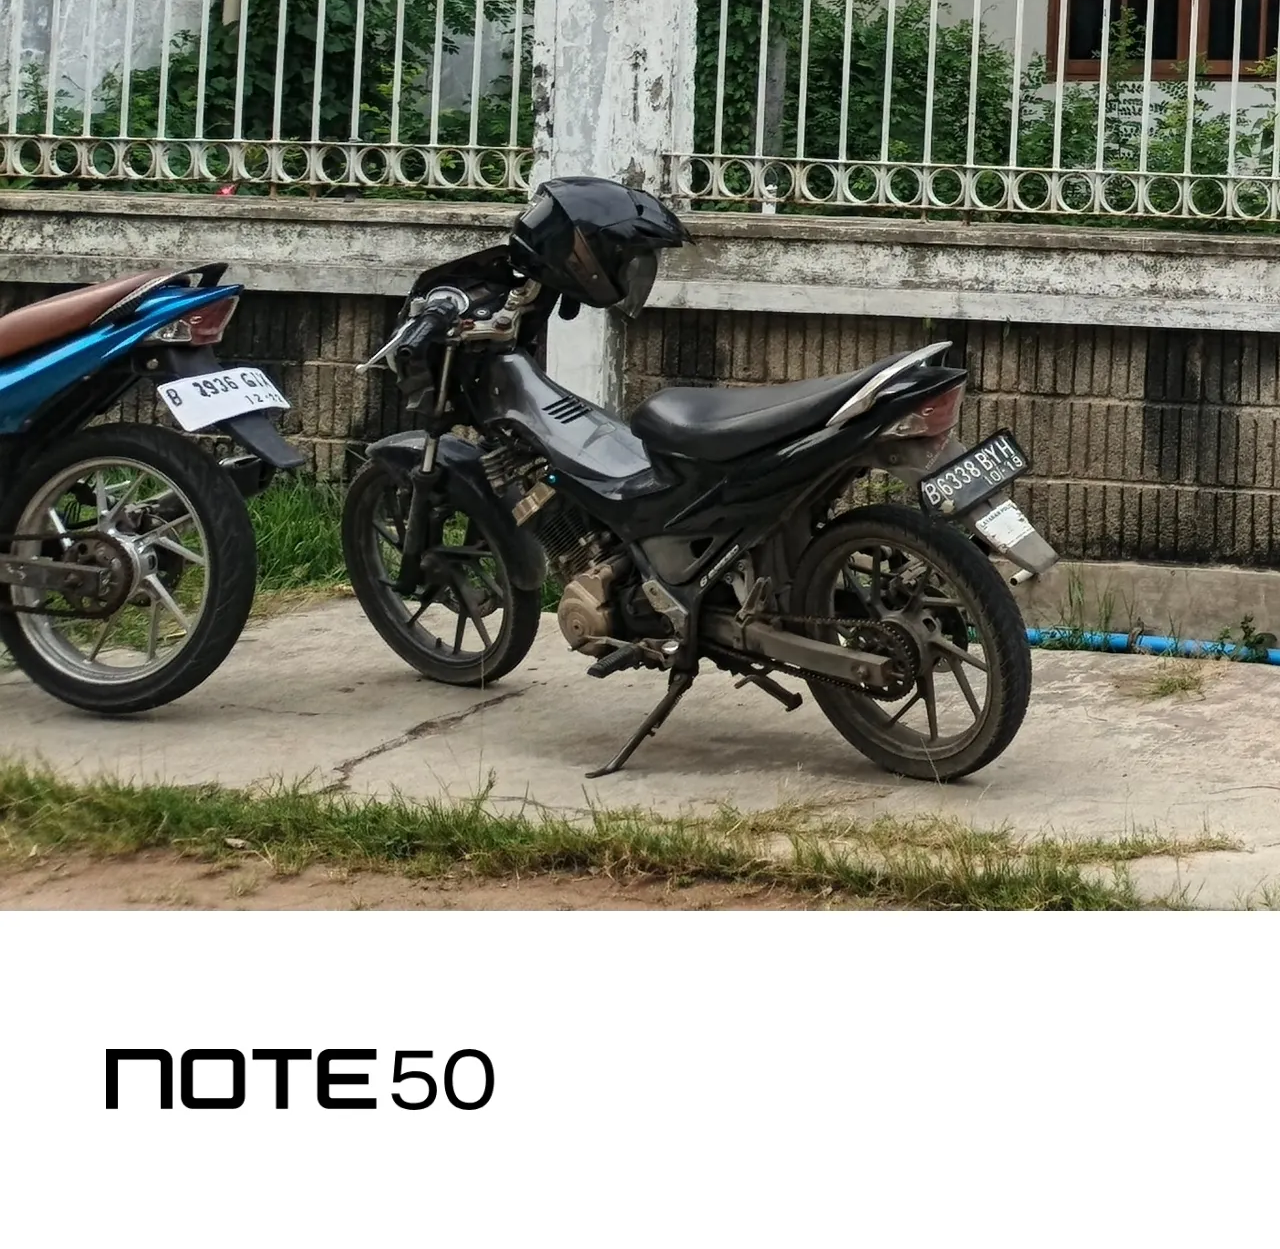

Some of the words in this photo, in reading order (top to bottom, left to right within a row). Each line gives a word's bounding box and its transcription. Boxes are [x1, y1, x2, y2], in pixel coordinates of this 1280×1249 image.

[166, 388, 183, 407] B
[924, 482, 941, 506] B
[936, 460, 981, 496] 6338
[974, 435, 1015, 472] BYH
